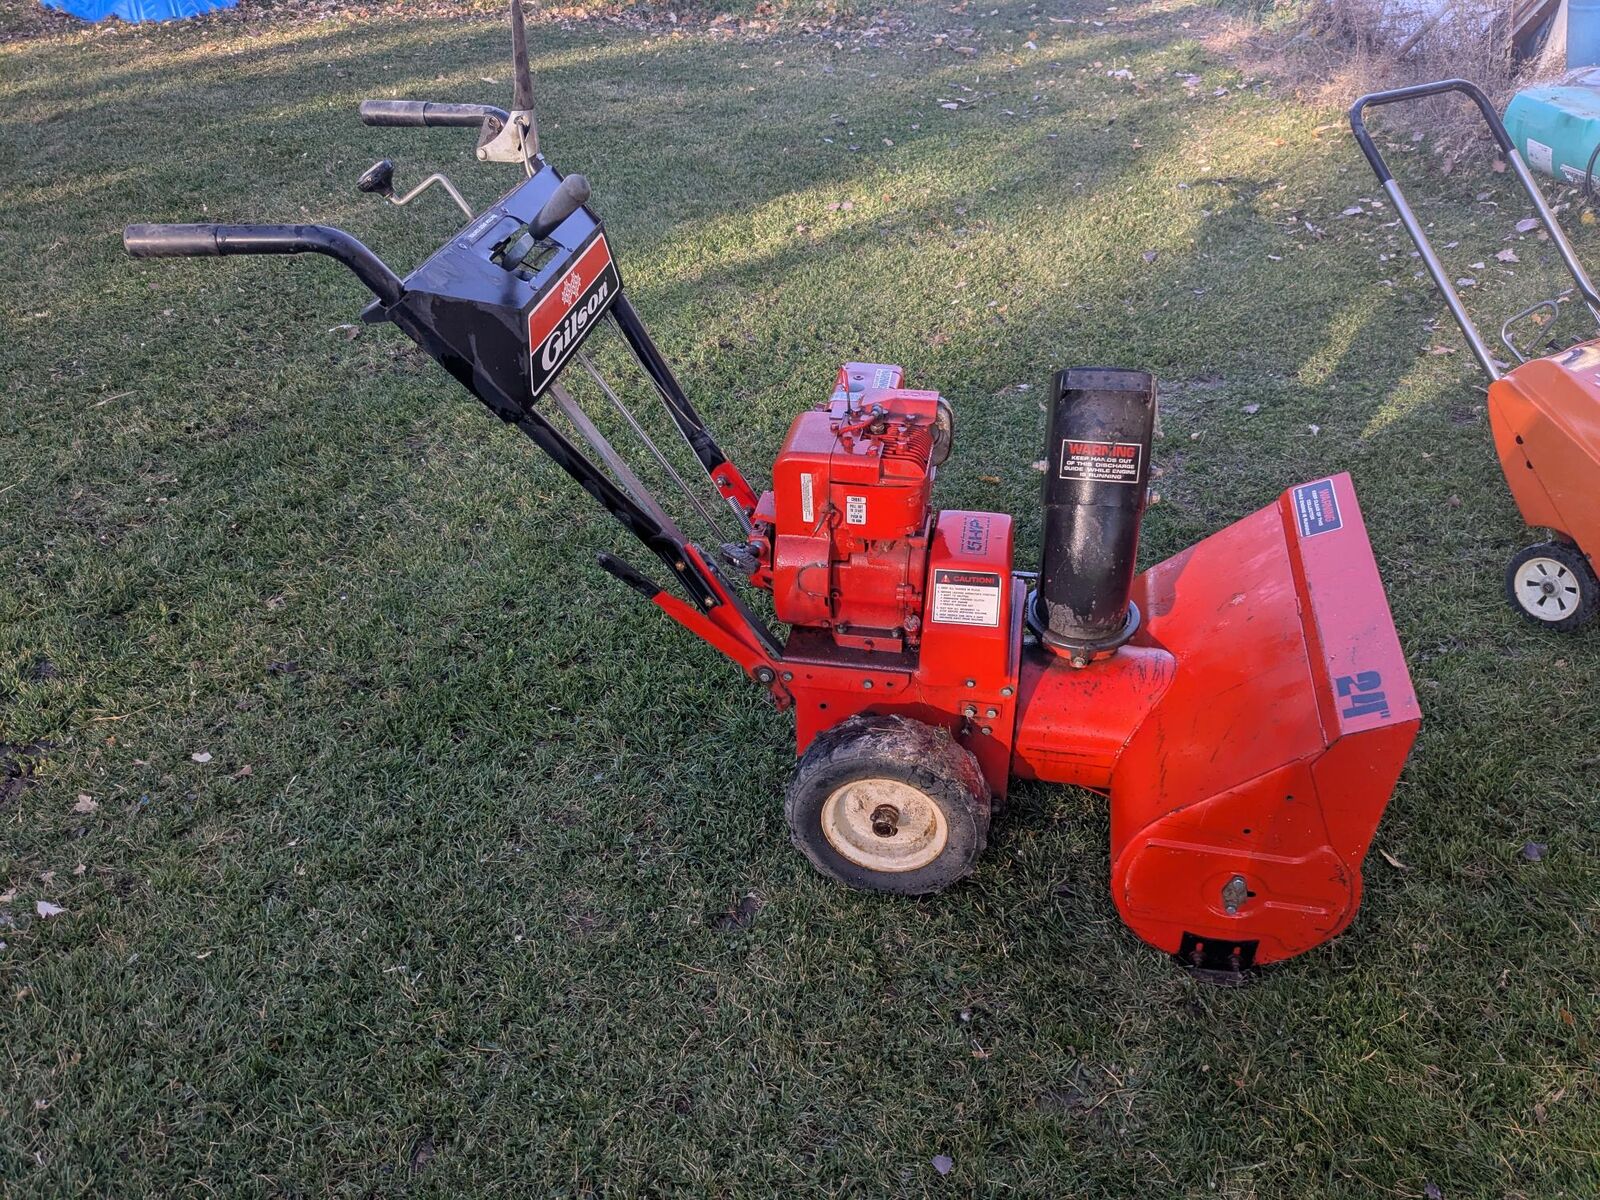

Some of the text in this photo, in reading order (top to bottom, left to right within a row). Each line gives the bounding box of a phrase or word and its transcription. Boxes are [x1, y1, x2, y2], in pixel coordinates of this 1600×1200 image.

[541, 281, 609, 371] Gilson
[1069, 443, 1136, 458] WARNING
[1318, 488, 1335, 522] WARNING
[953, 575, 995, 584] CAUTION!
